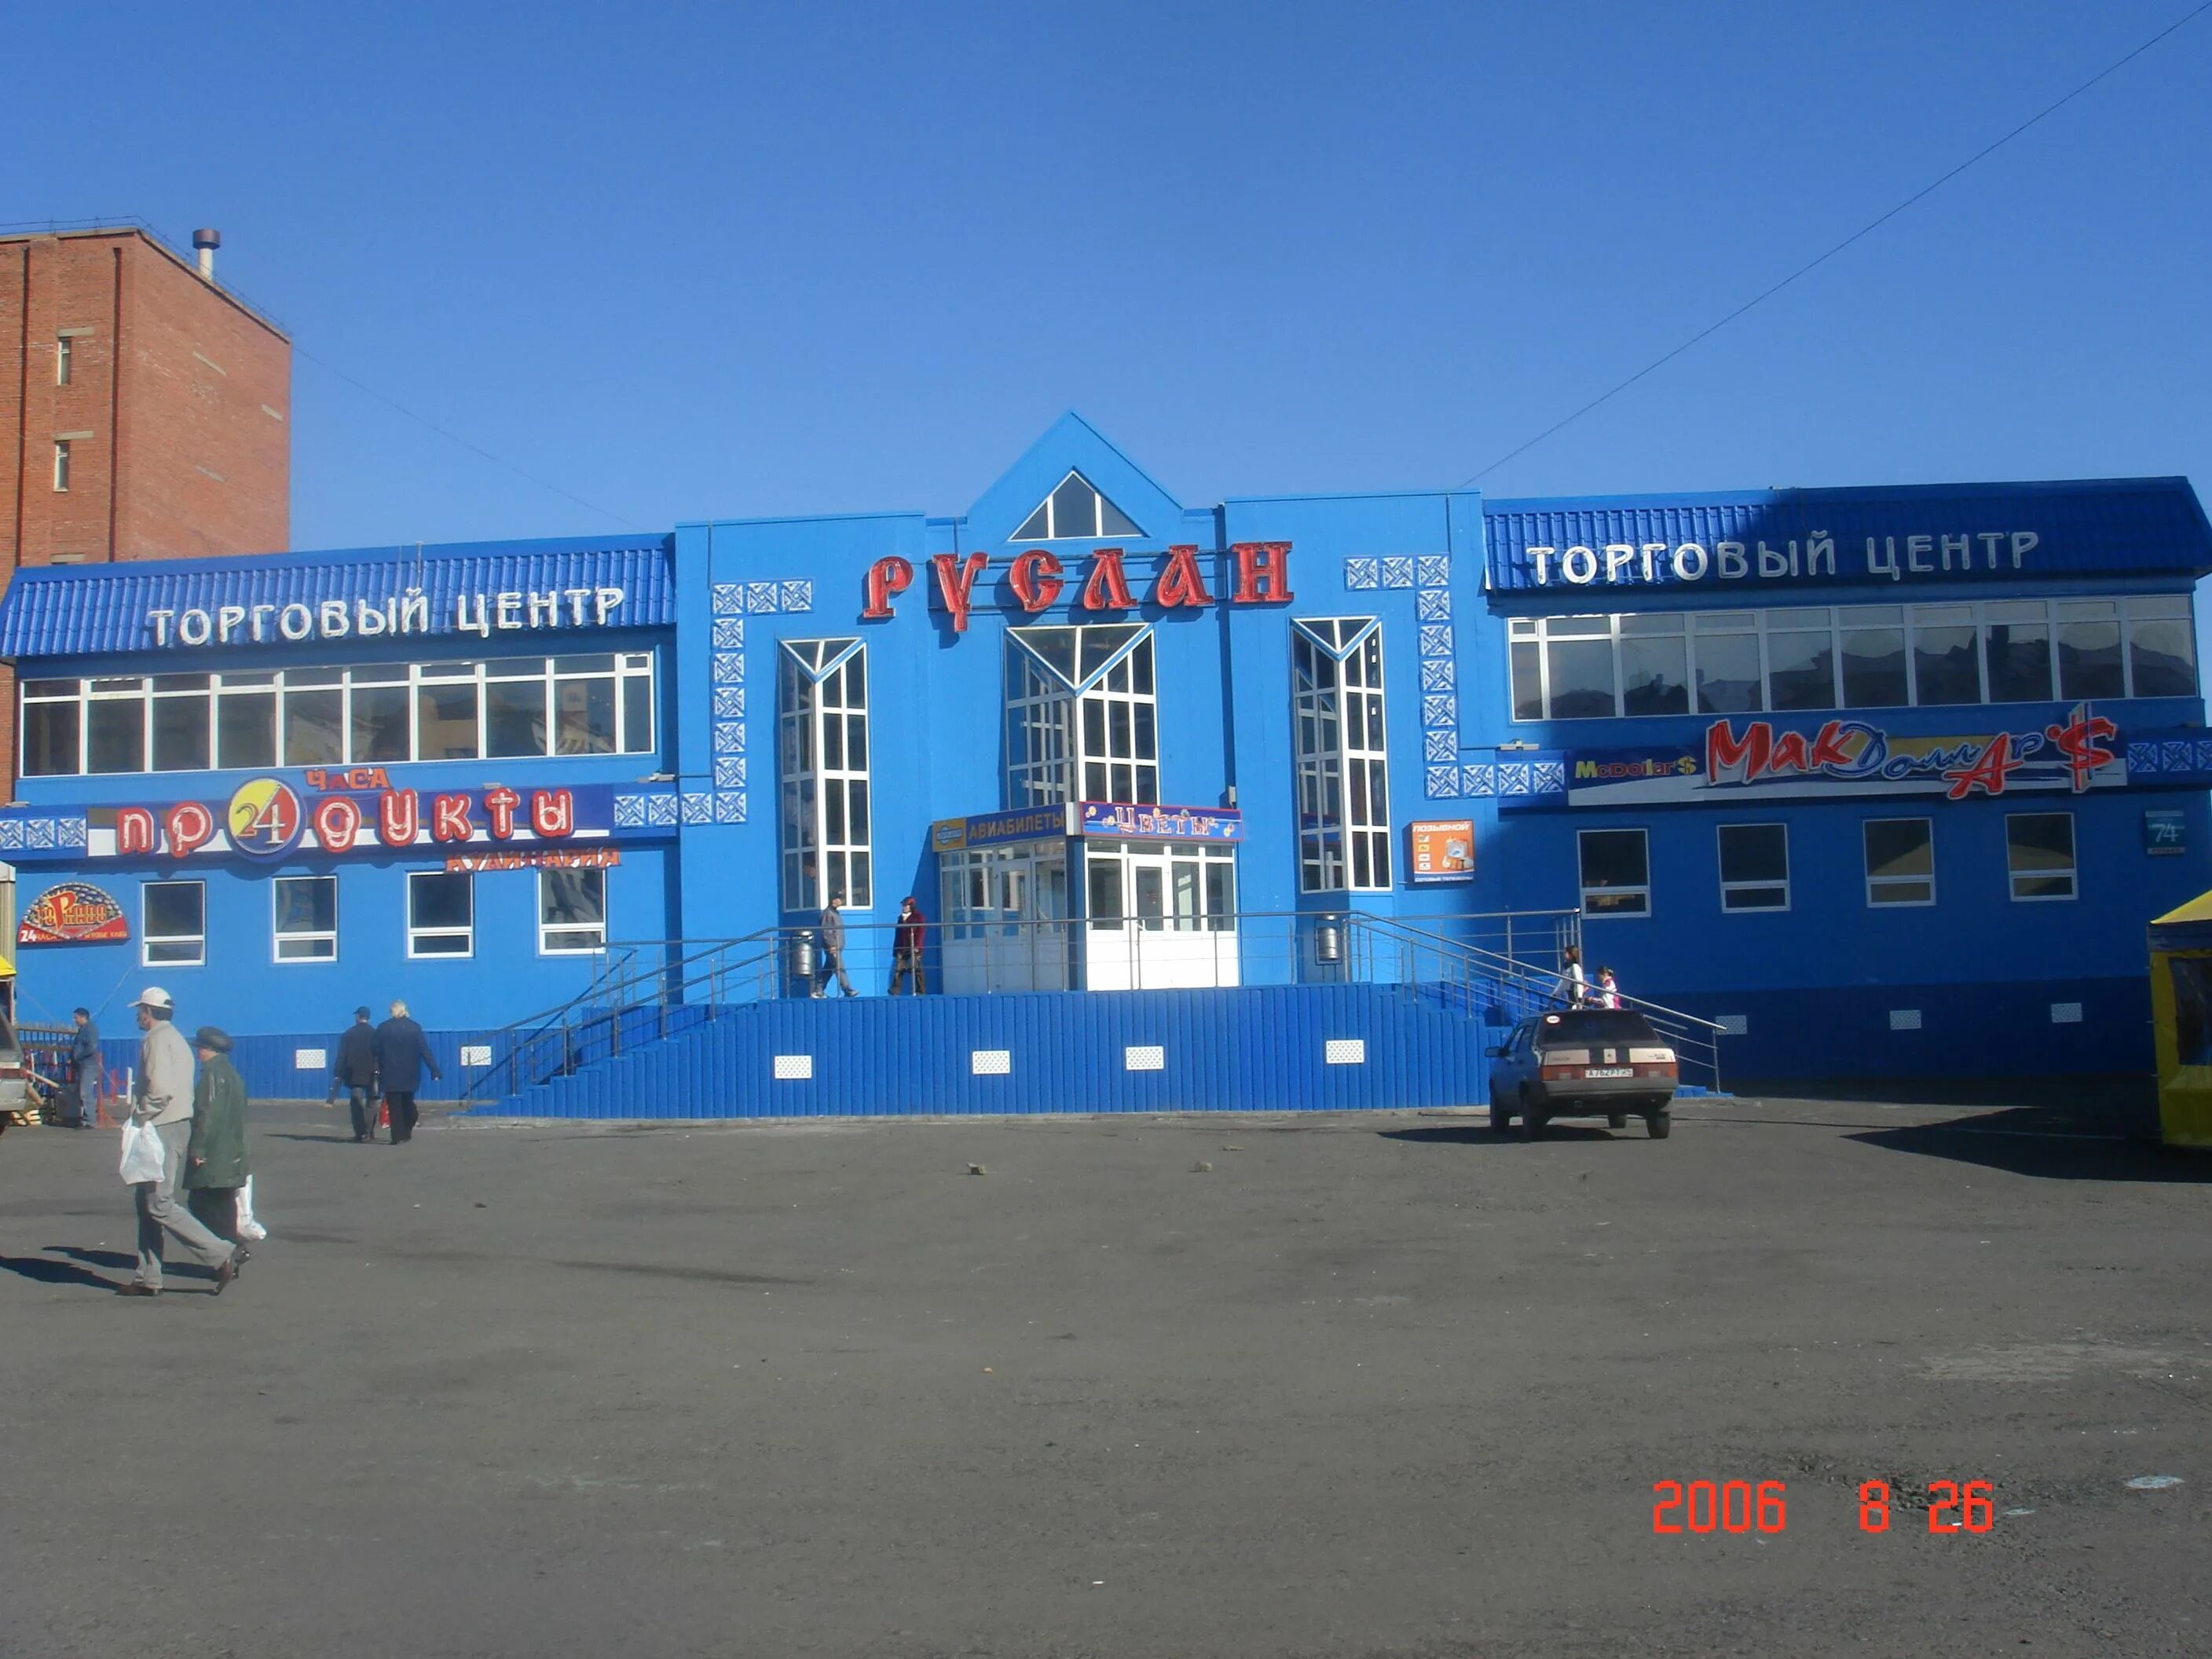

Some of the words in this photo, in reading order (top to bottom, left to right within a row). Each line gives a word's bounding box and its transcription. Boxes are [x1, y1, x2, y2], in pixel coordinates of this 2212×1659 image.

[1525, 530, 1836, 584] ТОРГОВЫЙ
[1866, 531, 2040, 581] ЦЕНТР
[148, 587, 429, 646] ТОРГОВЫЙ
[457, 588, 624, 638] ЦЕНТР
[239, 801, 285, 845] 24
[306, 767, 390, 792] ЧАСА
[969, 811, 1067, 840] АВИАБИЛЕТЫ
[2149, 822, 2179, 843] 74
[20, 930, 37, 943] 24
